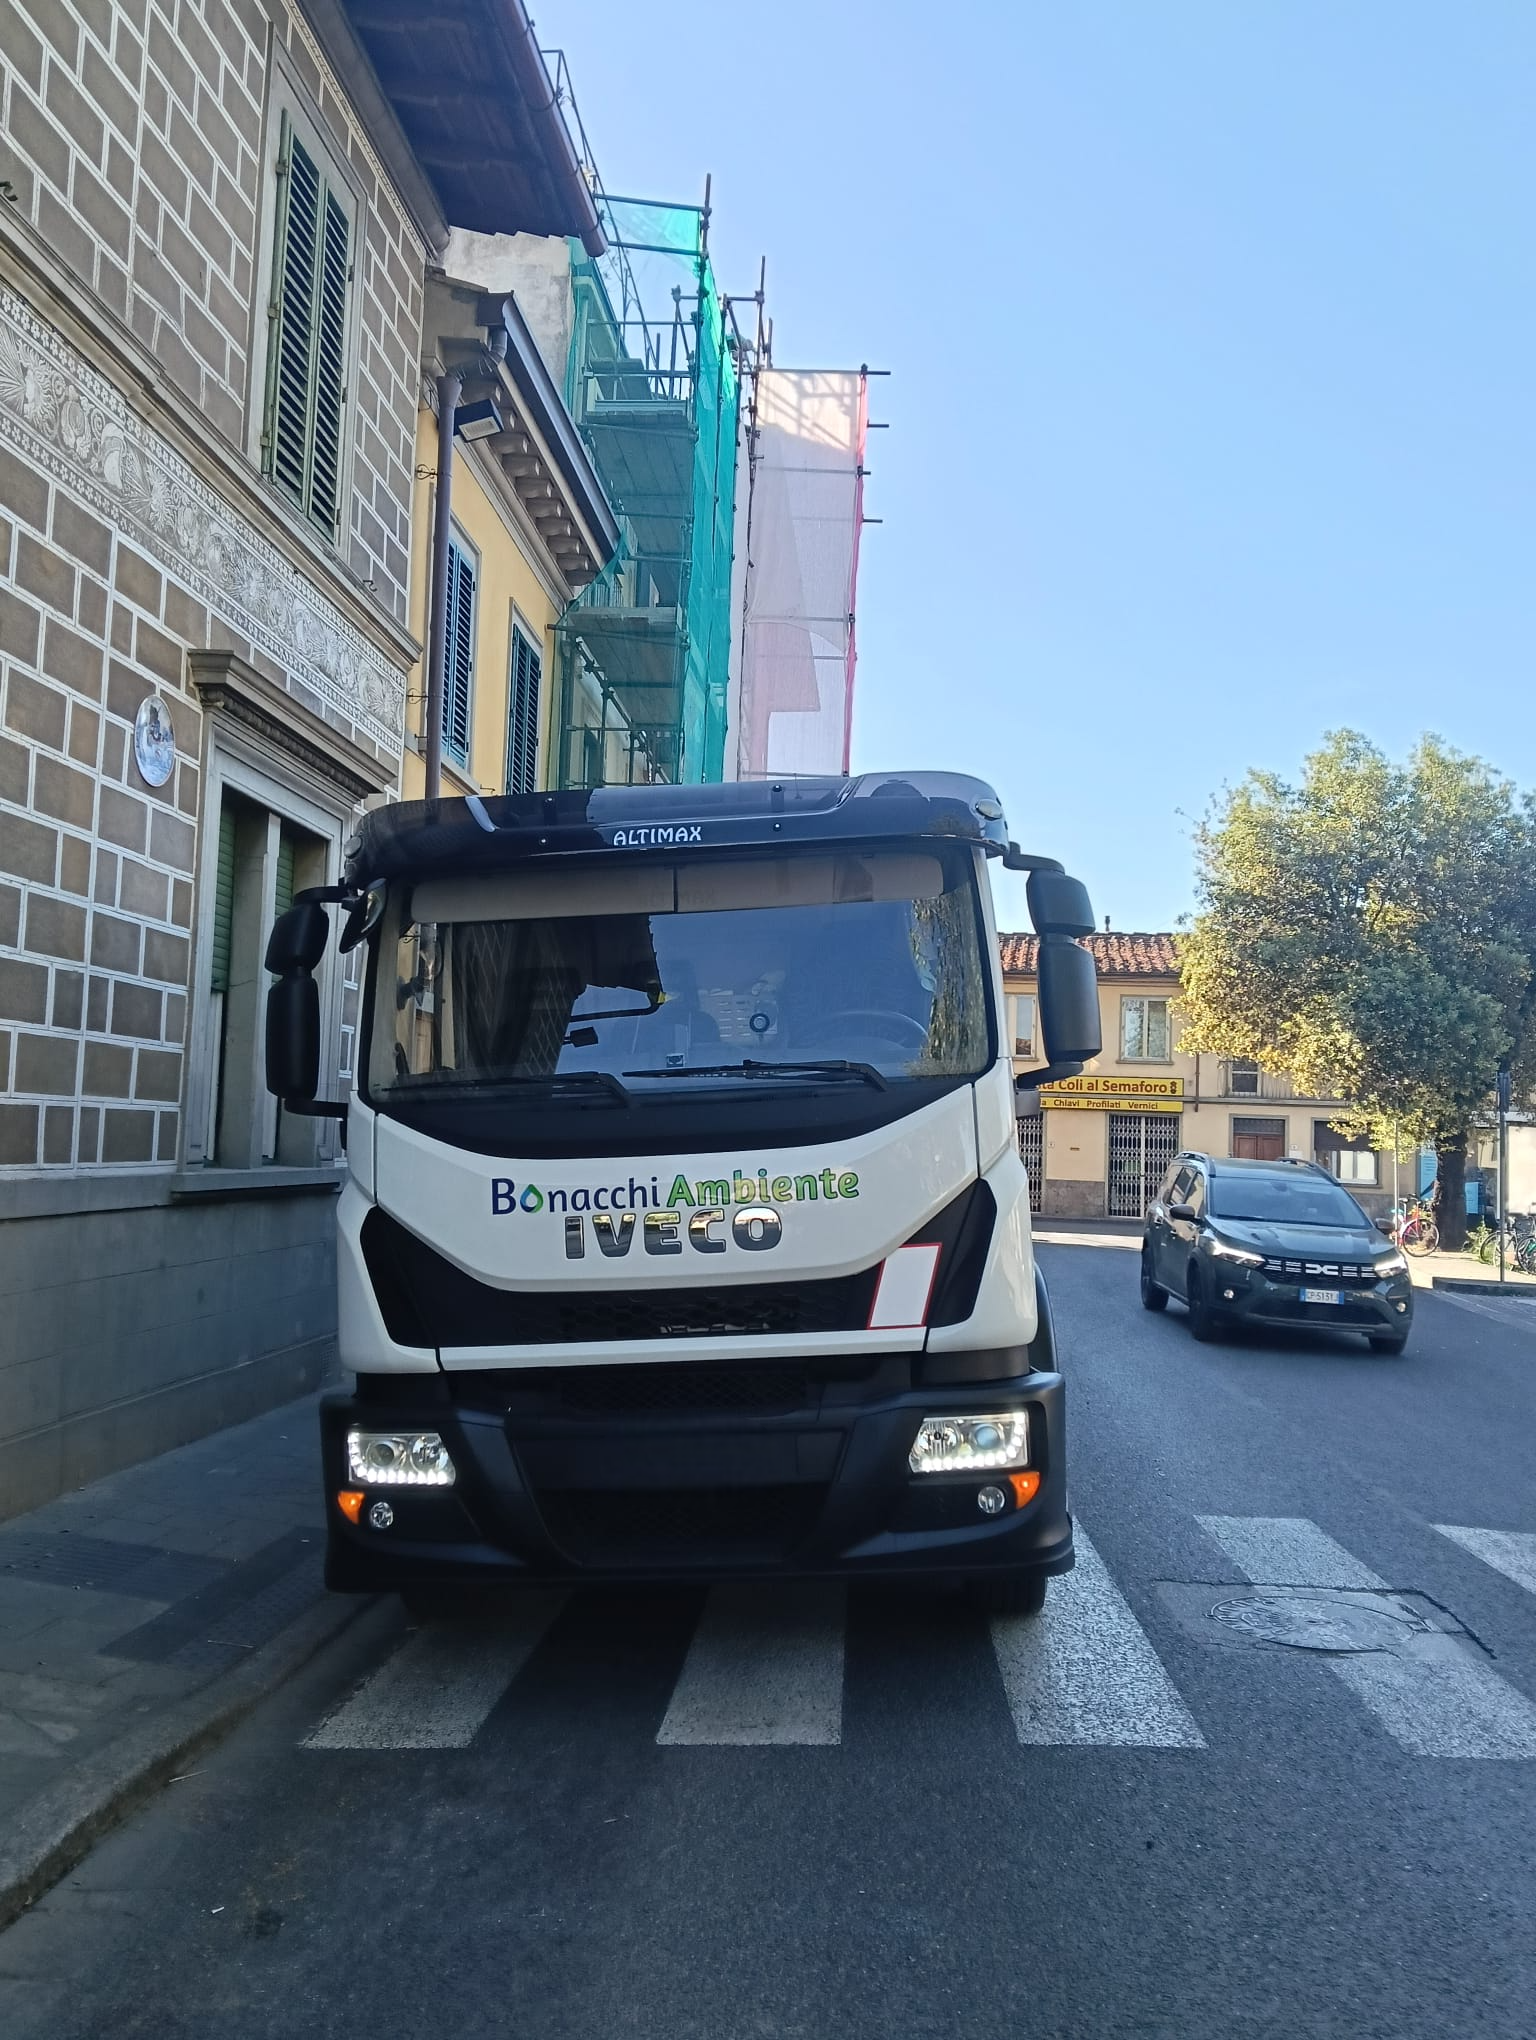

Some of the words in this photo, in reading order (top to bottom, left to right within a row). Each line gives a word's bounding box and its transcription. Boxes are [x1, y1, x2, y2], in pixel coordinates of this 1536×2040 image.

[613, 826, 702, 846] ALTIMAX
[1058, 1079, 1083, 1091] Coli
[1086, 1079, 1099, 1092] al
[1102, 1080, 1168, 1094] Semaforo
[1053, 1099, 1080, 1107] Chiavi
[1086, 1100, 1121, 1109] Profilati
[1128, 1101, 1158, 1110] Vernici
[491, 1176, 661, 1215] Bonacchi
[666, 1168, 860, 1207] Ambiente
[565, 1206, 783, 1259] IVECO
